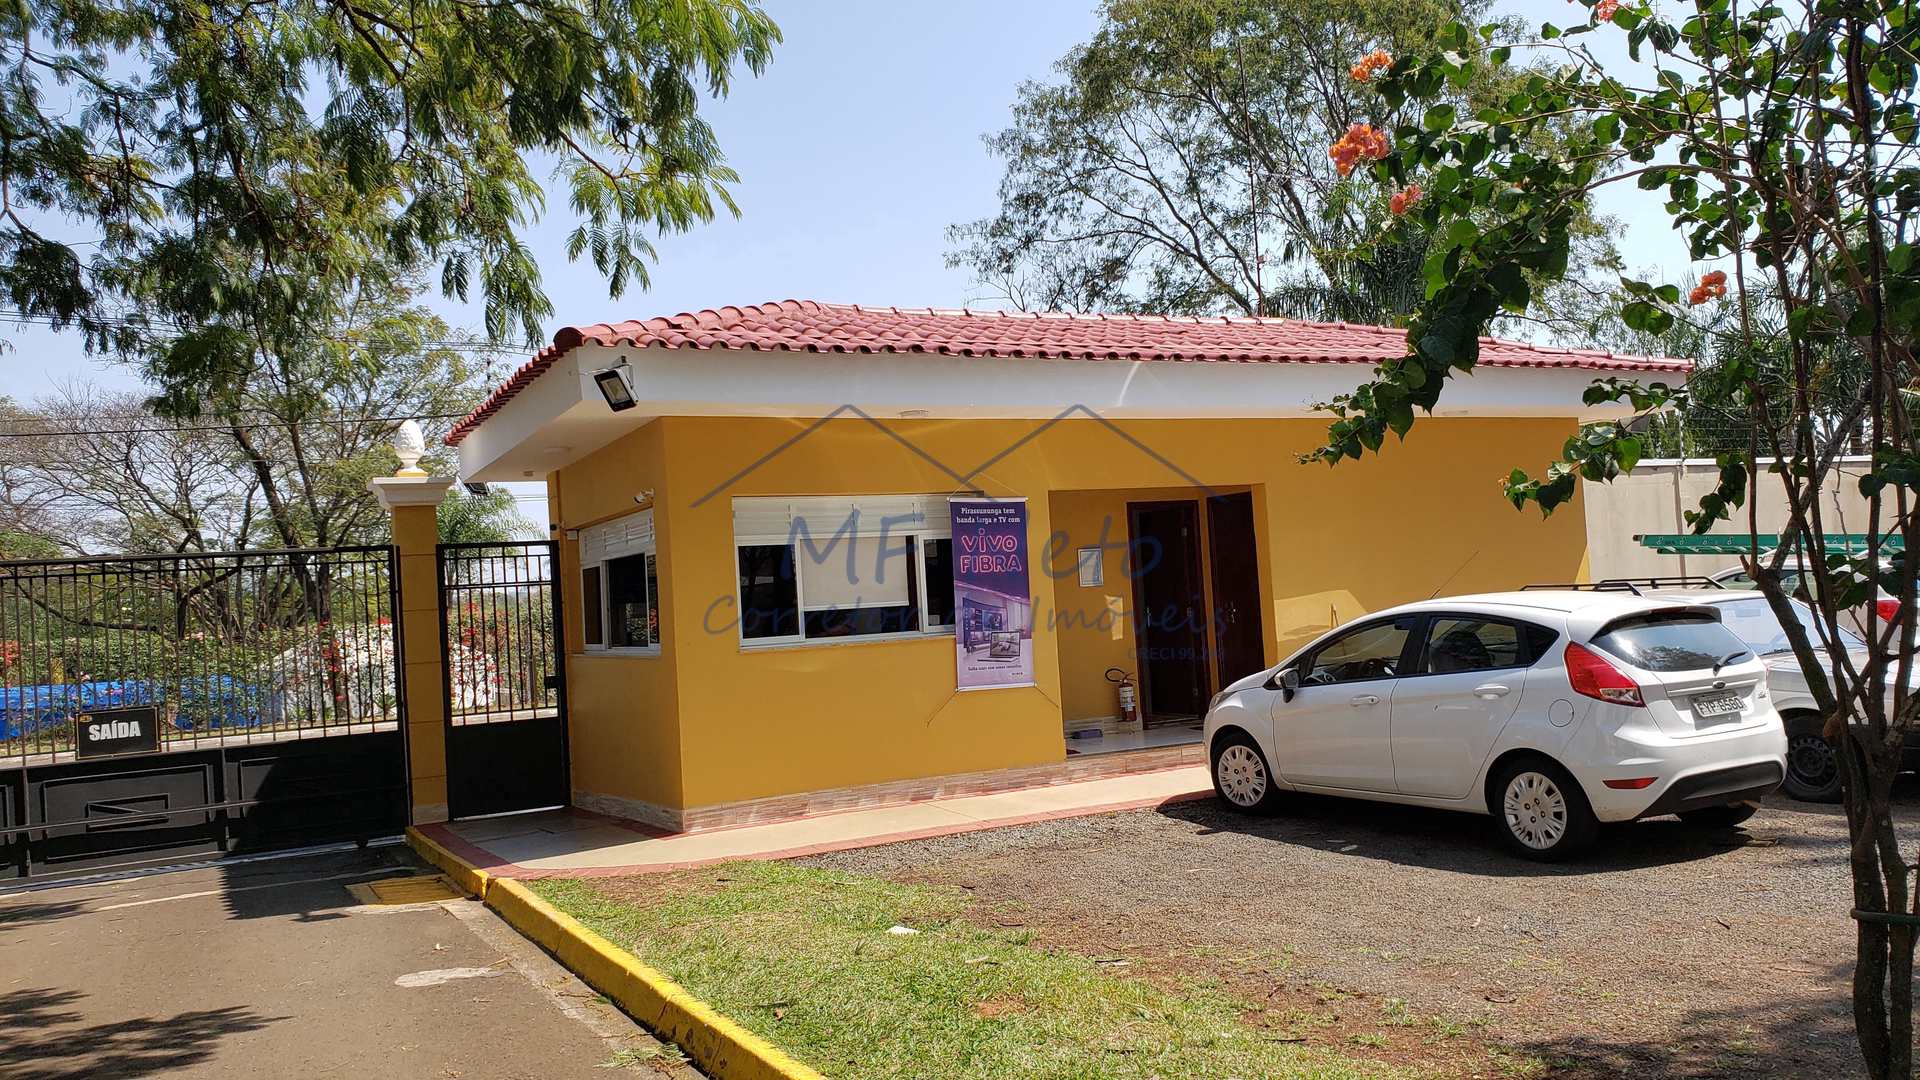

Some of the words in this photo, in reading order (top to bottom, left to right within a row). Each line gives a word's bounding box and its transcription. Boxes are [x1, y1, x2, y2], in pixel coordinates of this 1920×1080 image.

[956, 516, 976, 524] banda
[977, 516, 992, 525] larga
[998, 516, 1007, 524] TV
[961, 528, 1018, 553] vivo
[960, 554, 1022, 574] FIBRA
[89, 720, 142, 741] SAÍDA
